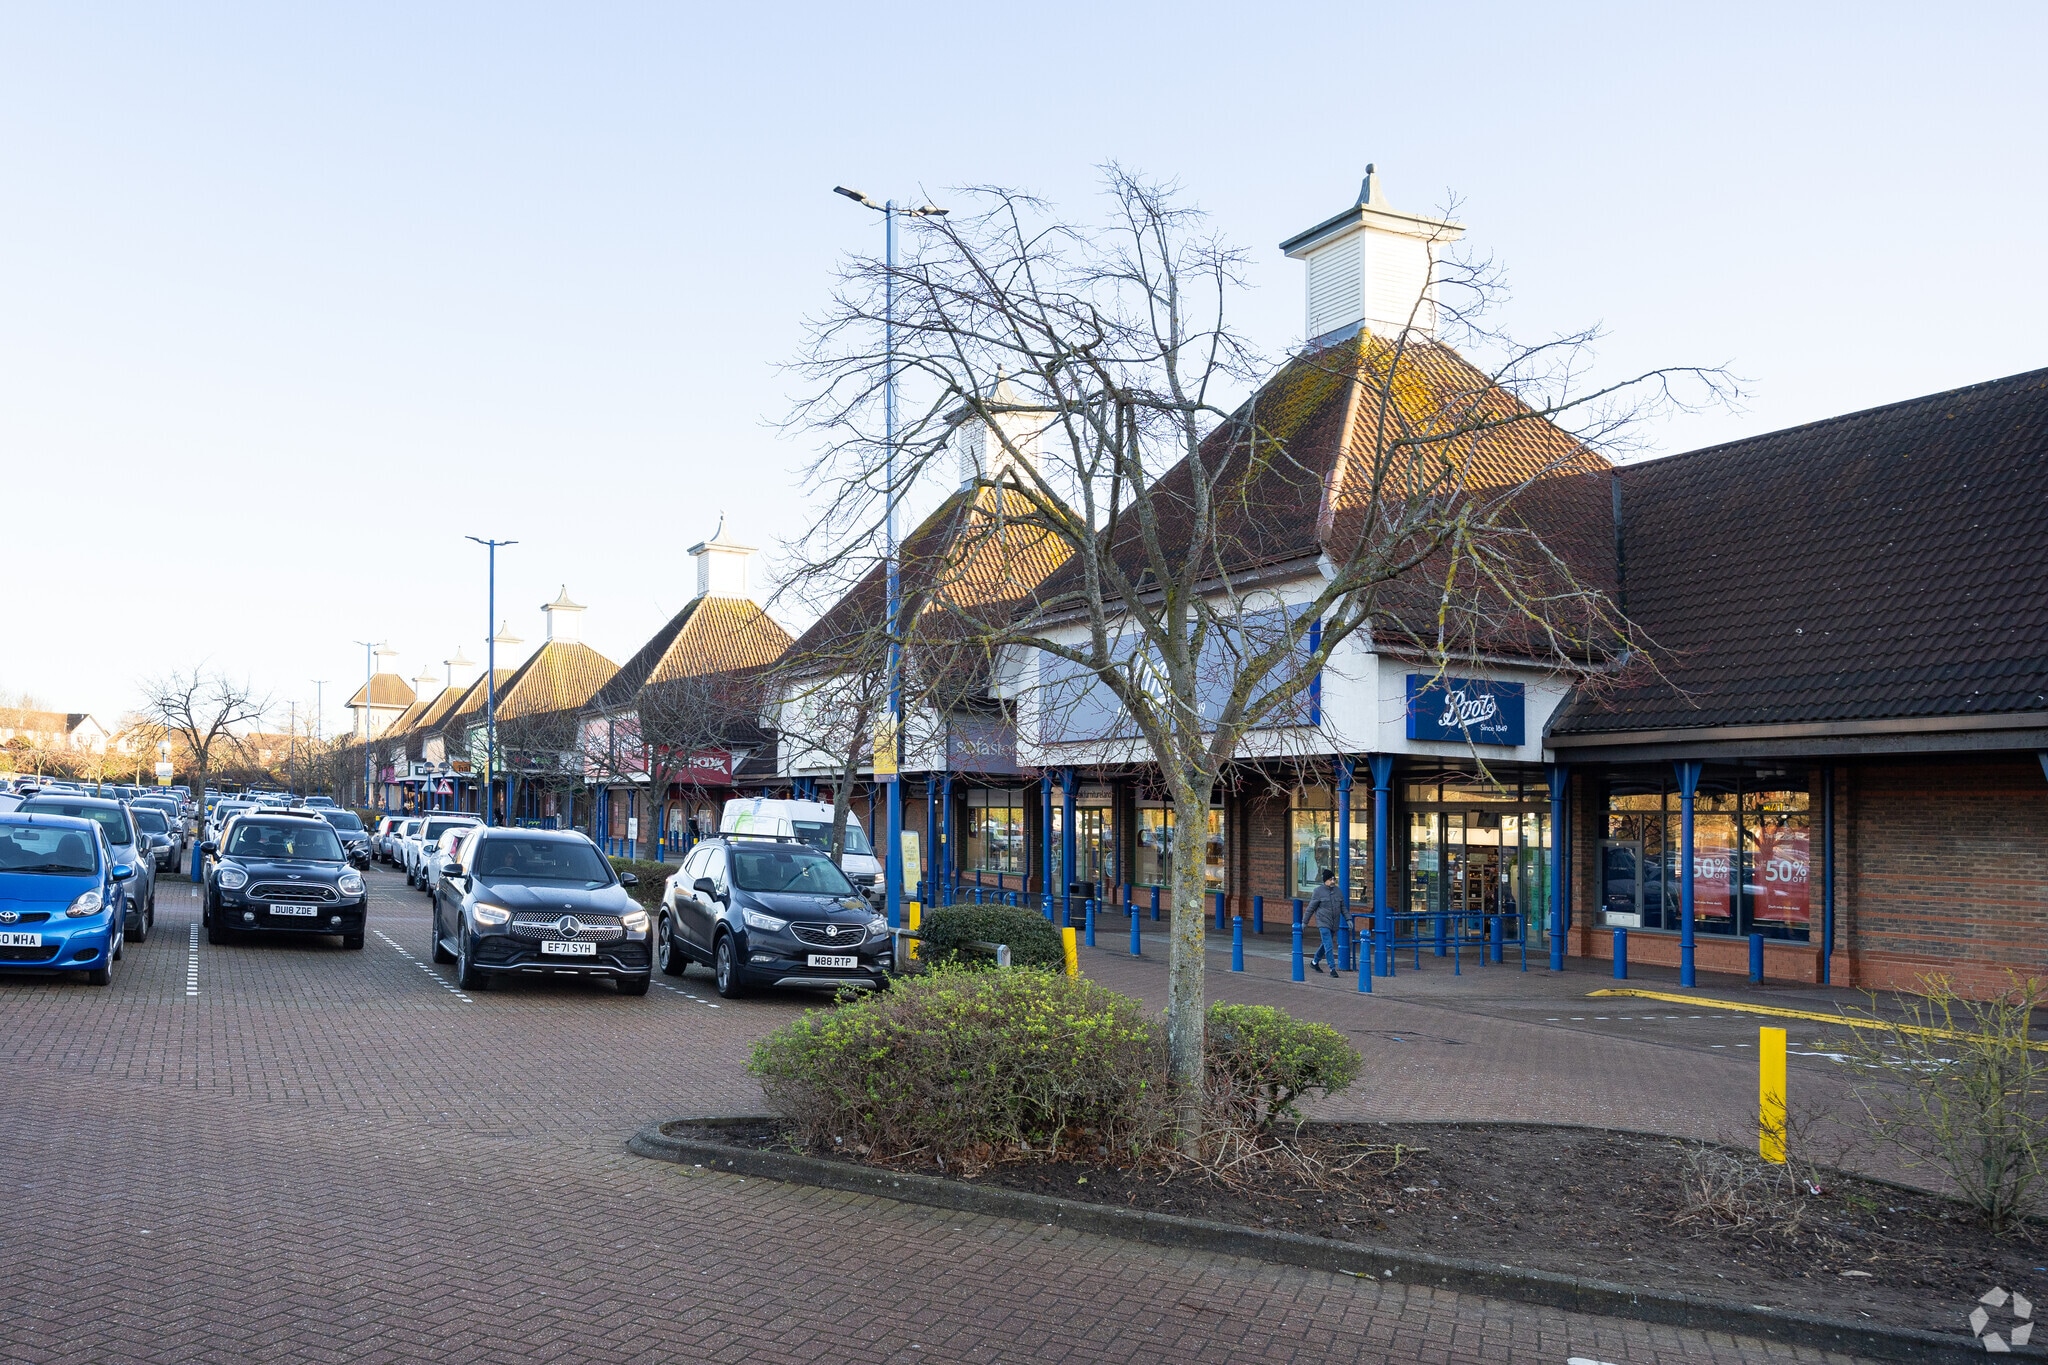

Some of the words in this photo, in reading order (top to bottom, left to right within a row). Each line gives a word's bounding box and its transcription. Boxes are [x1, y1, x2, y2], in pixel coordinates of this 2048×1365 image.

[1438, 690, 1497, 729] Boots
[1480, 724, 1495, 732] Since
[1495, 724, 1508, 732] 1849
[956, 736, 1016, 757] sofastor
[1765, 860, 1807, 882] 50%
[275, 905, 294, 914] DU18
[295, 906, 312, 915] ZDE
[0, 933, 9, 944] 0
[13, 934, 36, 945] WHA
[548, 942, 570, 952] EF71
[572, 943, 591, 953] SYH
[814, 956, 832, 966] M88
[834, 957, 852, 966] RTP
